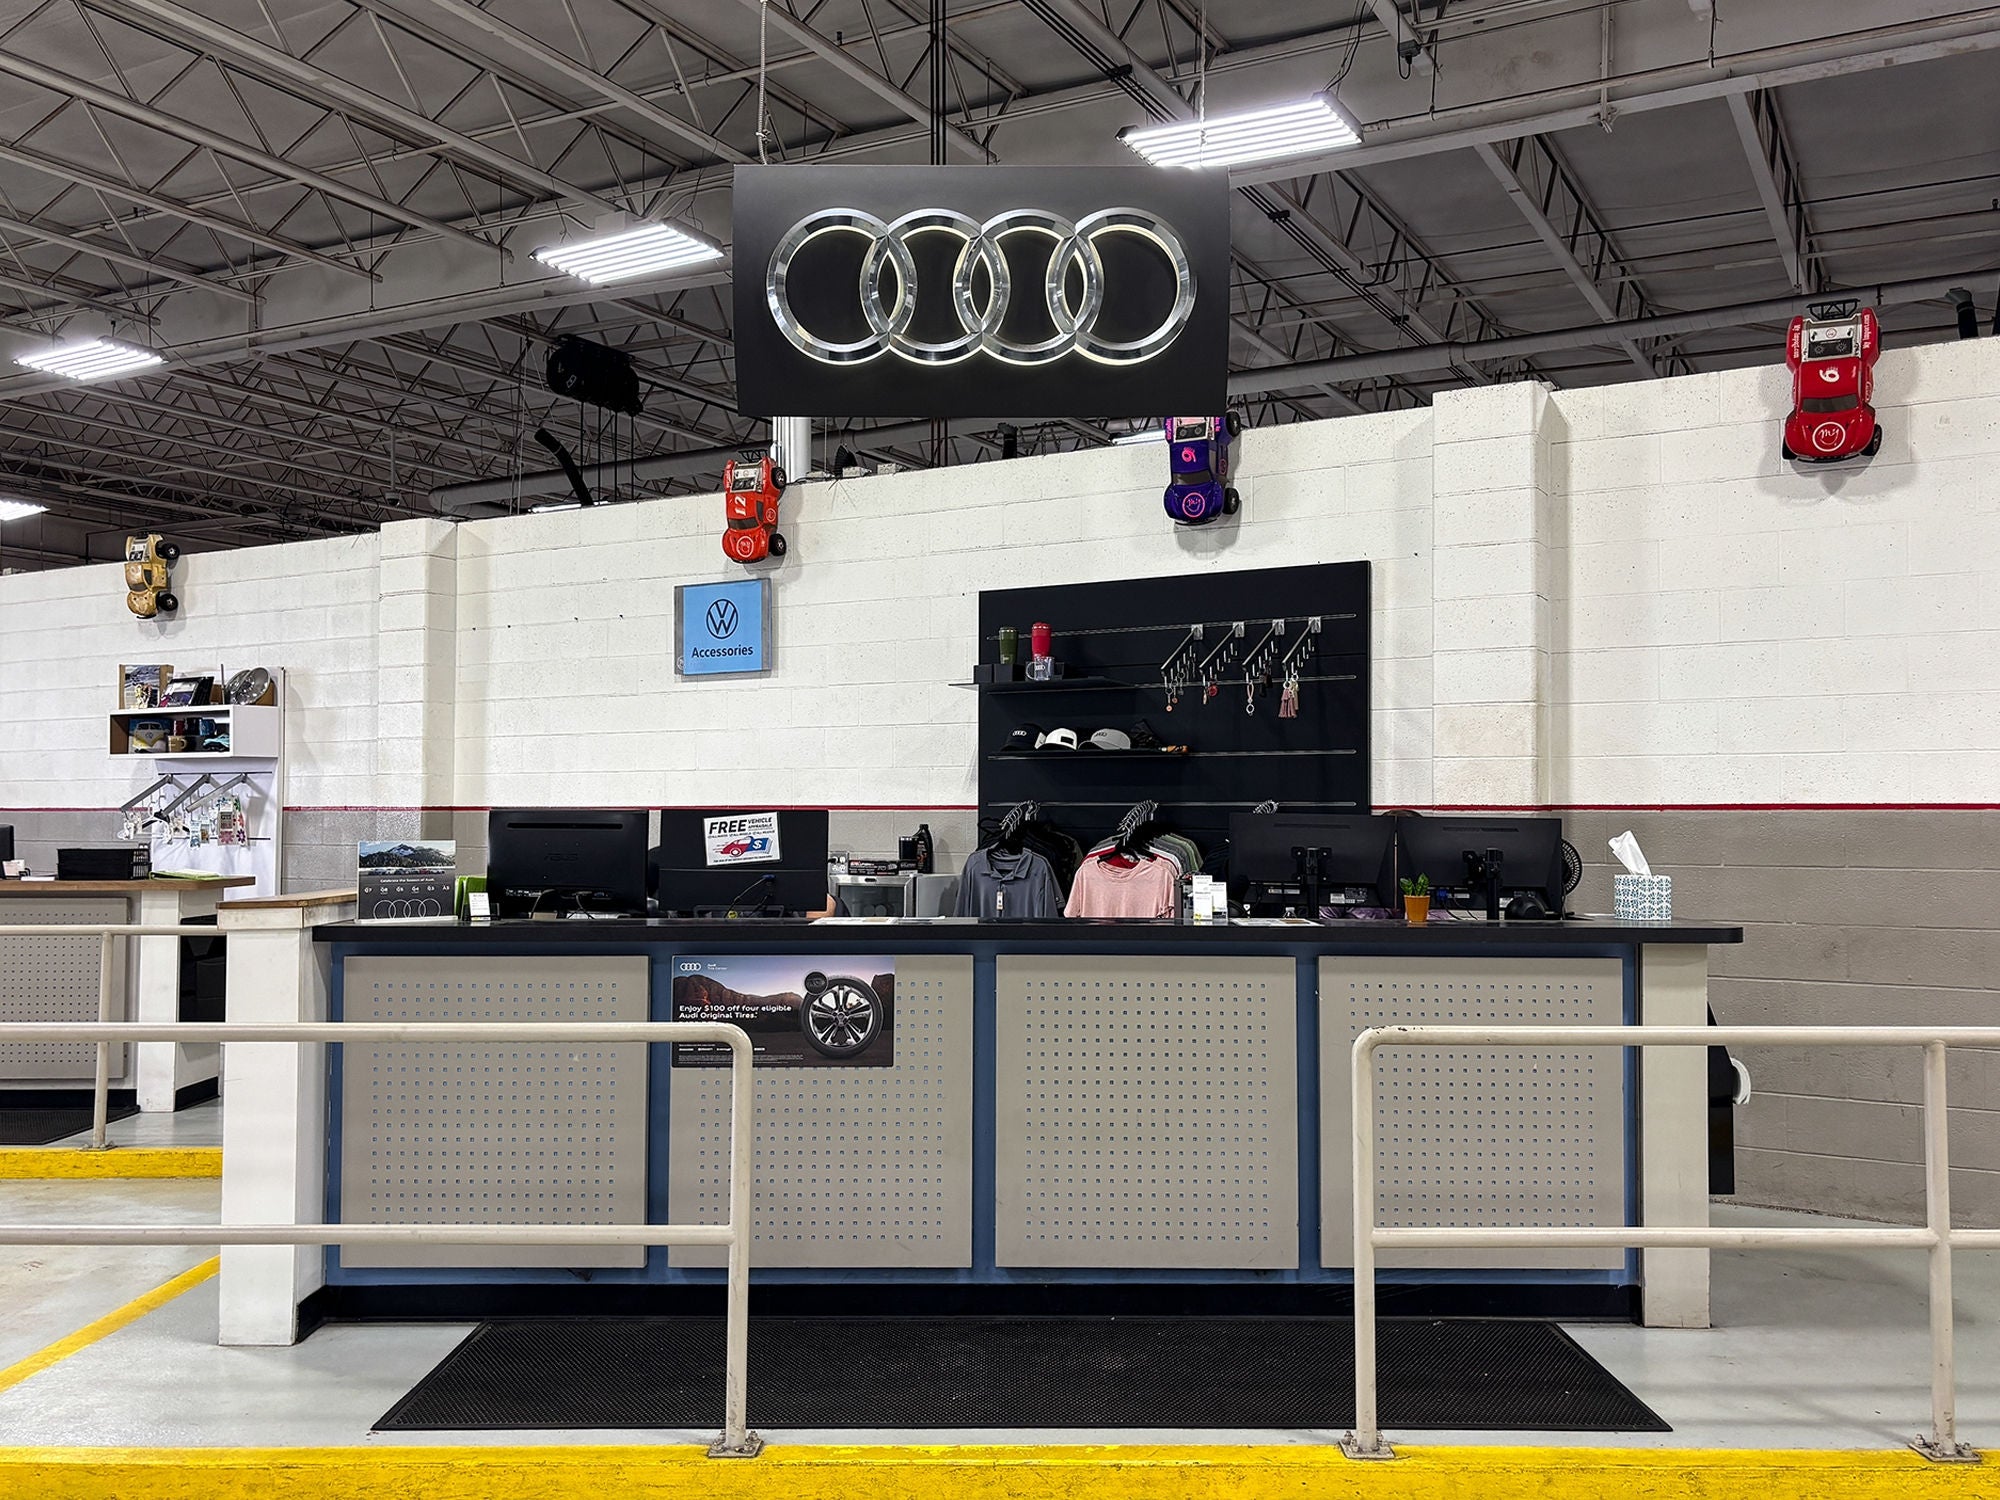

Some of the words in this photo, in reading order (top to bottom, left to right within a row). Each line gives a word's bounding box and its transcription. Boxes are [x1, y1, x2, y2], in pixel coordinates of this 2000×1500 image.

[691, 644, 754, 659] Accessories
[747, 816, 773, 824] VEHICLE
[708, 819, 748, 835] FREE
[679, 1005, 702, 1013] Enjoy
[761, 1005, 792, 1013] eligible
[700, 1012, 733, 1020] Original
